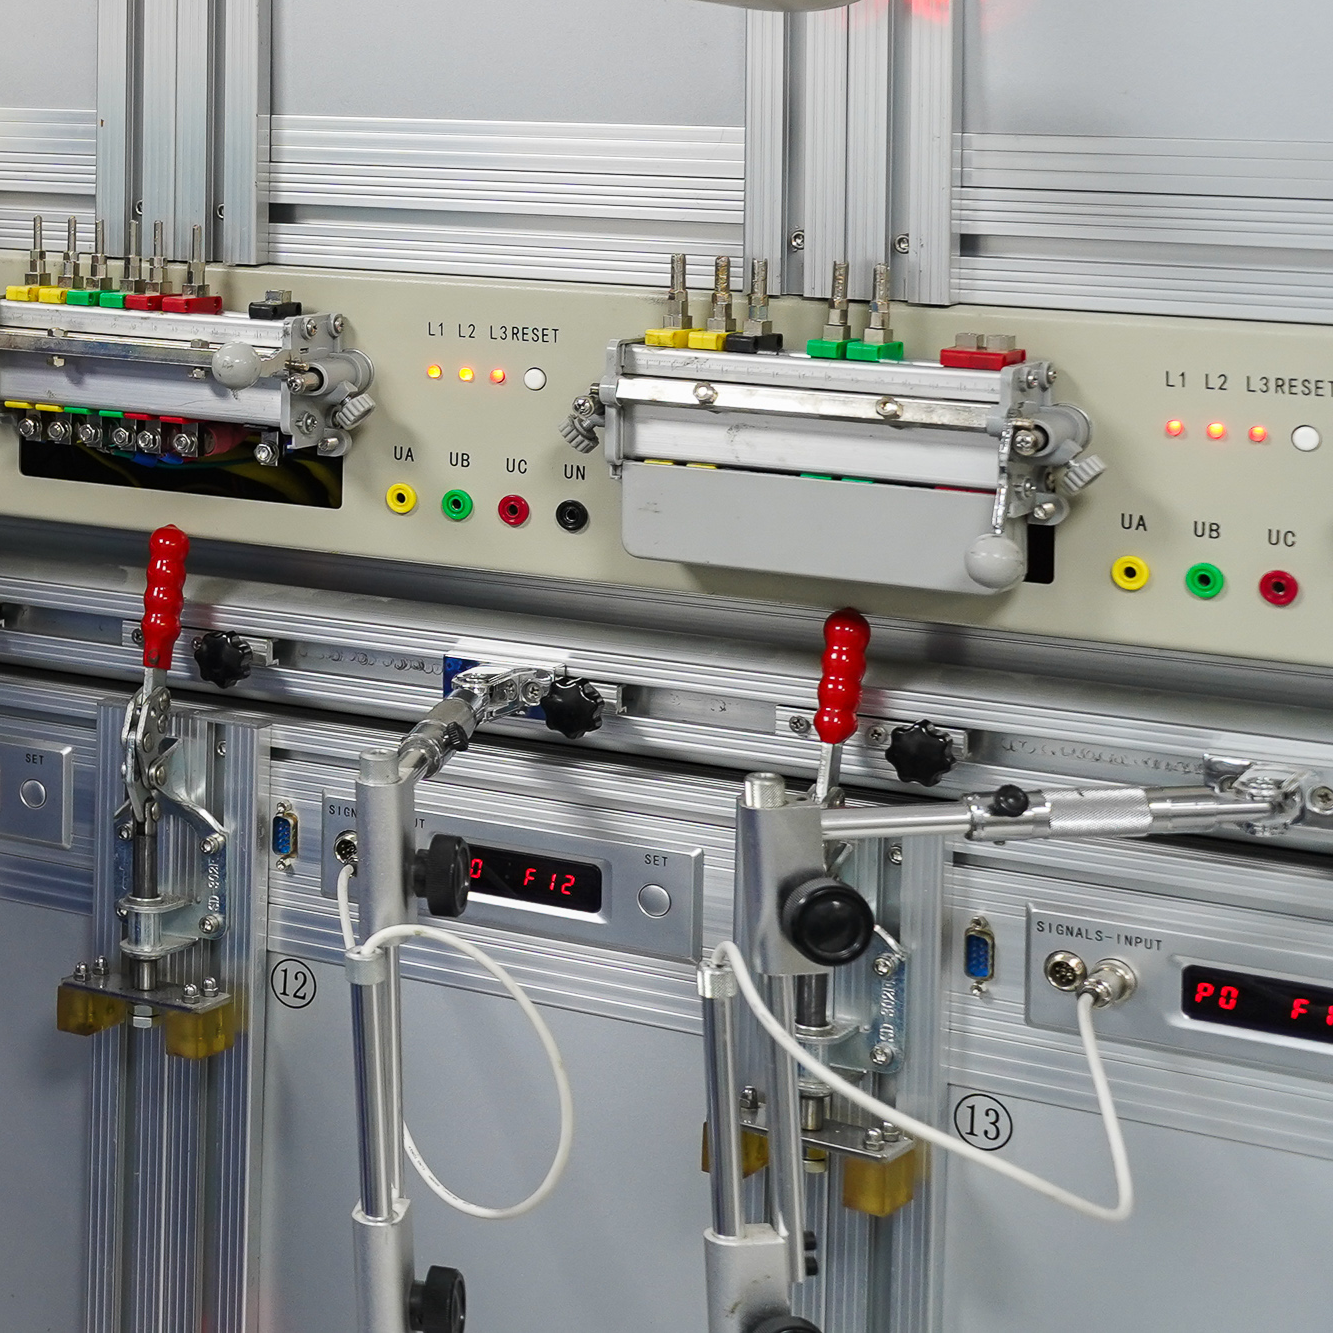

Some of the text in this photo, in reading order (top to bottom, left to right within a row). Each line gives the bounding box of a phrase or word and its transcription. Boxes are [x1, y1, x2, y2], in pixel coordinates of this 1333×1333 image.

[428, 322, 559, 344] L1 L2 L3 RESET
[1165, 370, 1187, 388] L1
[1204, 373, 1228, 391] L2
[1246, 375, 1270, 394] L3
[394, 446, 586, 480] UA UB UC UN
[1121, 513, 1297, 548] UA UB UC
[25, 753, 45, 766] SET
[644, 854, 668, 867] SET
[470, 859, 576, 895] 0 F12
[1036, 921, 1163, 951] SIGNALS-INPUT
[278, 968, 308, 999] 12
[966, 1104, 1001, 1141] 13
